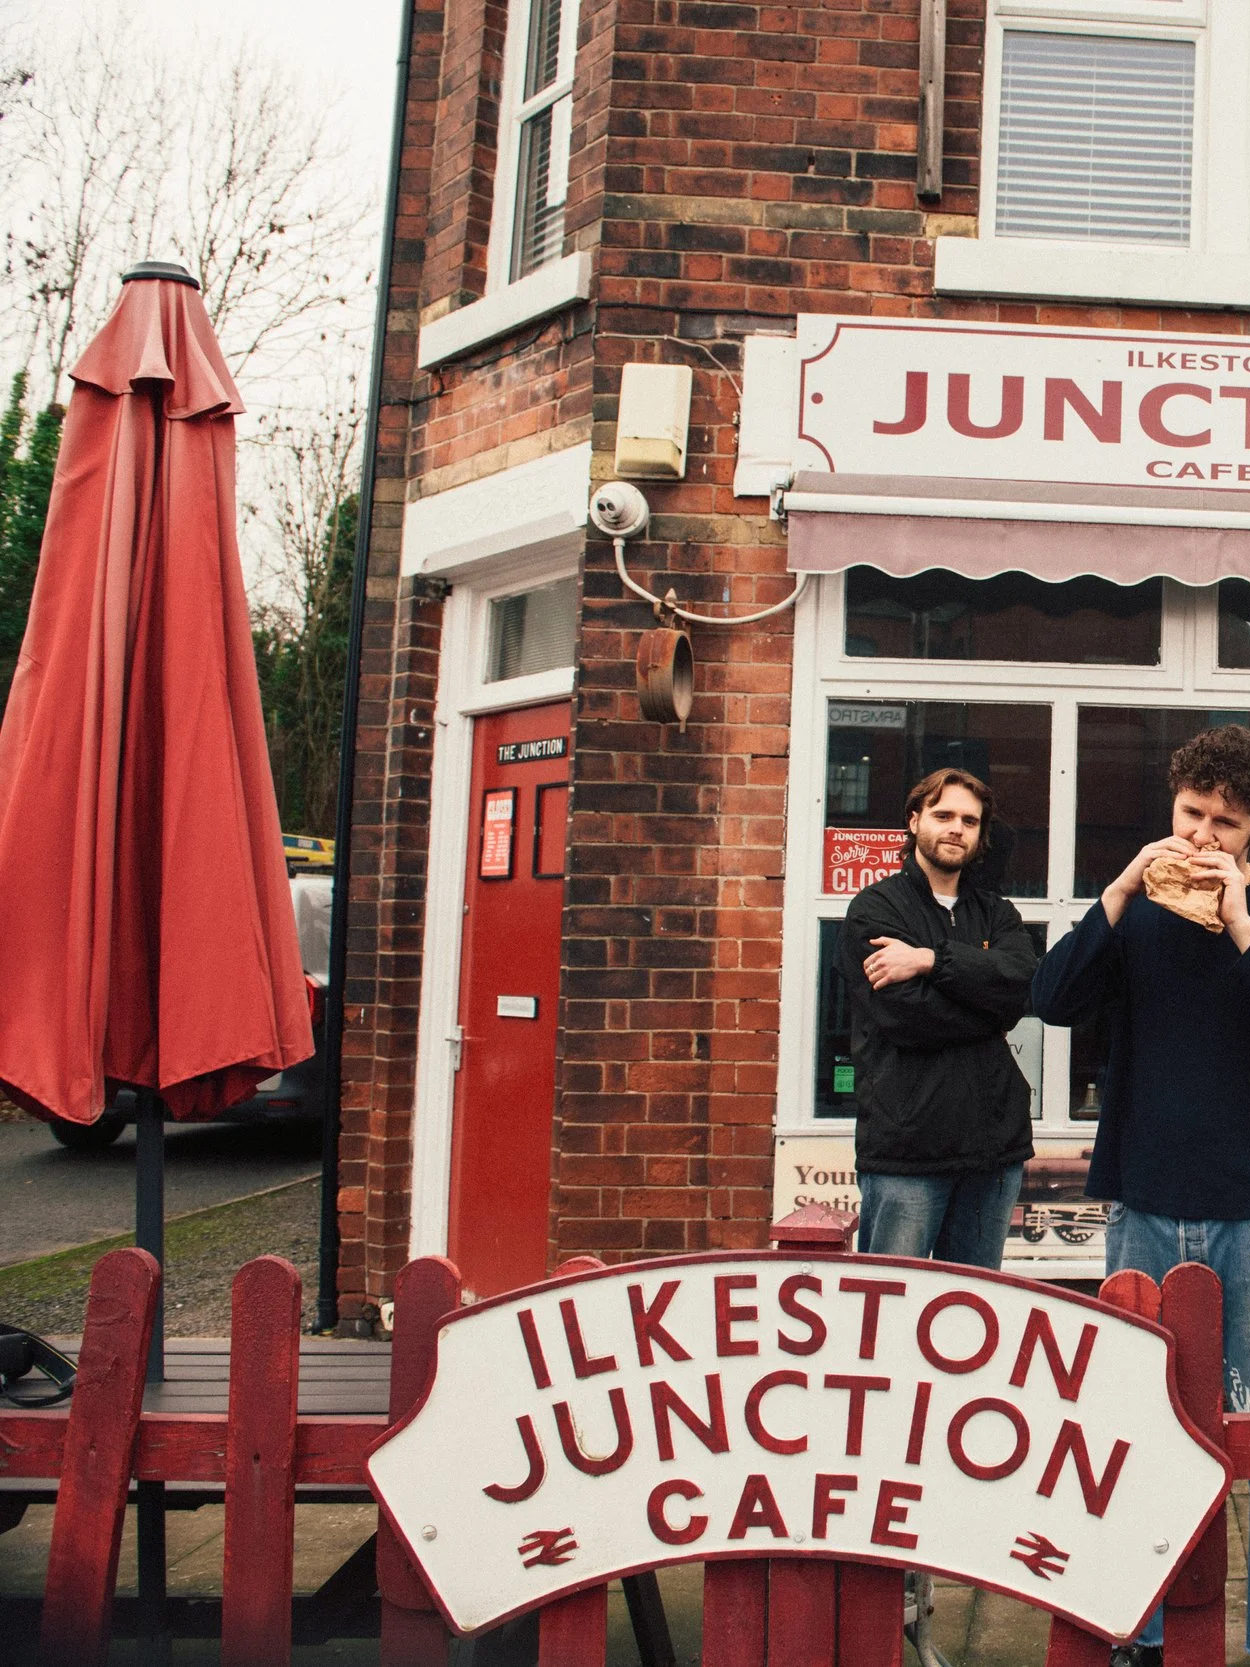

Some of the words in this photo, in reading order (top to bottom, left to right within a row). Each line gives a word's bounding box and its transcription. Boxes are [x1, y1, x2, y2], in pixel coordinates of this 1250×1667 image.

[498, 744, 517, 761] THE
[518, 738, 563, 759] JUNCTION
[832, 832, 885, 842] JUNCTION
[829, 845, 879, 867] Sorry
[881, 850, 900, 863] WE
[832, 867, 902, 892] CLO
[516, 1273, 1098, 1402] ILKESTON
[483, 1370, 1131, 1519] JUNCTION
[646, 1473, 923, 1549] CAFE
